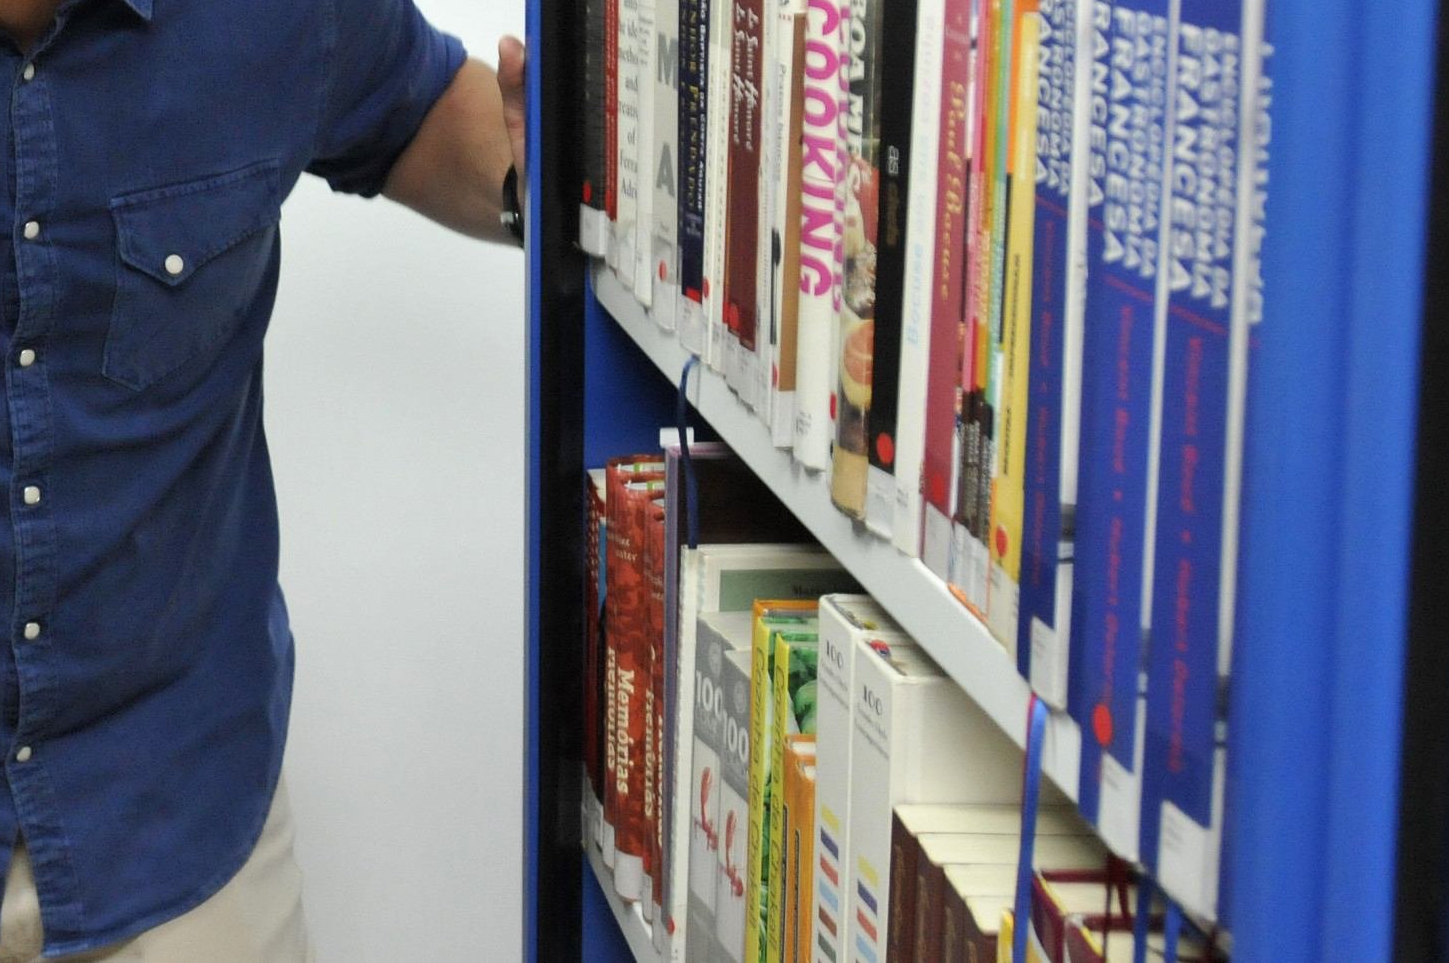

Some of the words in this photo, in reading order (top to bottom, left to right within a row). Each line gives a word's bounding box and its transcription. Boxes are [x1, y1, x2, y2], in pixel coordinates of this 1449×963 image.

[948, 82, 966, 170] Paul
[1102, 7, 1135, 264] FRANCESA
[1125, 11, 1152, 268] GASTRONOMIA
[1169, 22, 1204, 291] FRANCESA
[1190, 27, 1222, 298] GASTRONOMIA
[940, 174, 962, 304] Bocuse
[754, 646, 764, 765] Cozinha
[826, 639, 844, 669] 100
[863, 684, 884, 717] 100
[616, 666, 634, 795] Memórias
[723, 709, 749, 763] 100
[773, 664, 784, 785] Cozinha
[752, 774, 760, 811] de
[772, 793, 780, 831] de
[749, 818, 759, 931] Chakall
[770, 839, 780, 951] Chakall
